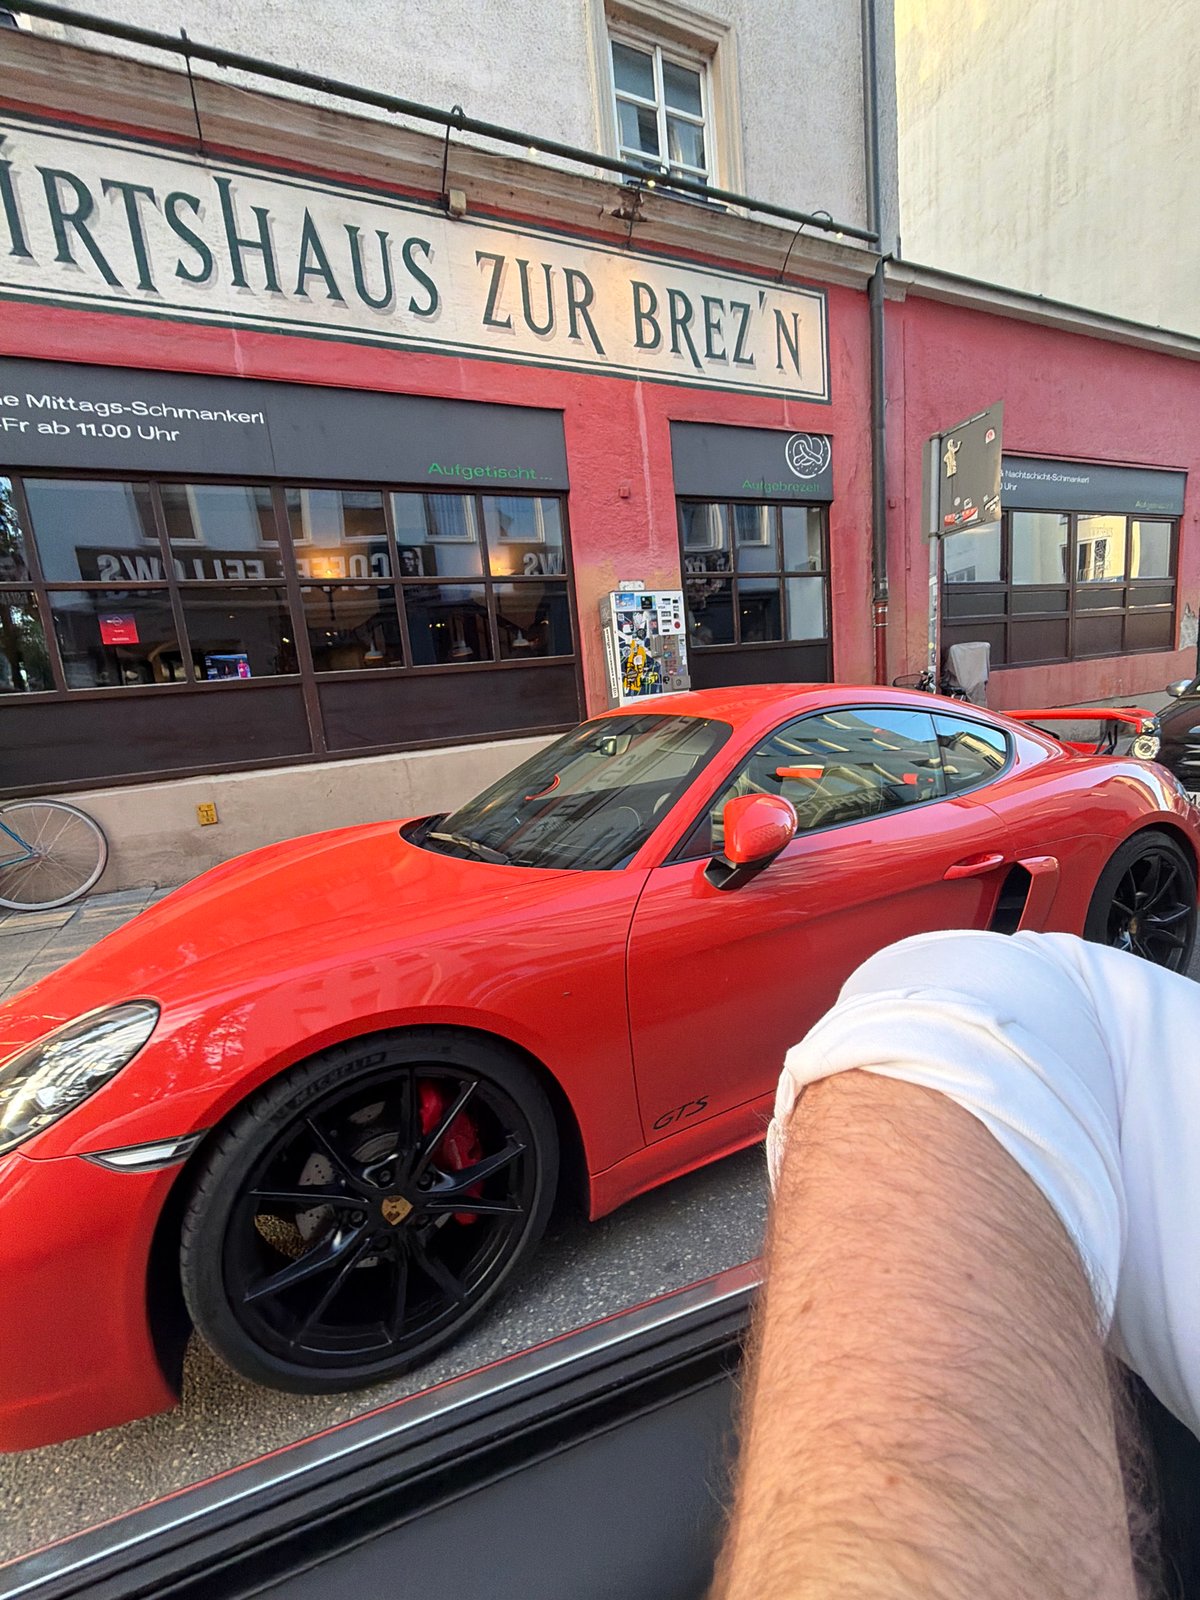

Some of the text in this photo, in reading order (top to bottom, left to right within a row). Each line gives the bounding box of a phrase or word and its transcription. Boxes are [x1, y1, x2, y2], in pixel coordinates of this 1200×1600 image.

[0, 134, 802, 379] IRTSHAUS ZUR BREZ'N
[26, 393, 264, 424] Mittags-Schmankerl
[37, 420, 70, 435] ab
[76, 422, 131, 438] 11.00
[137, 425, 180, 441] Uhr
[653, 1095, 709, 1129] GTS
